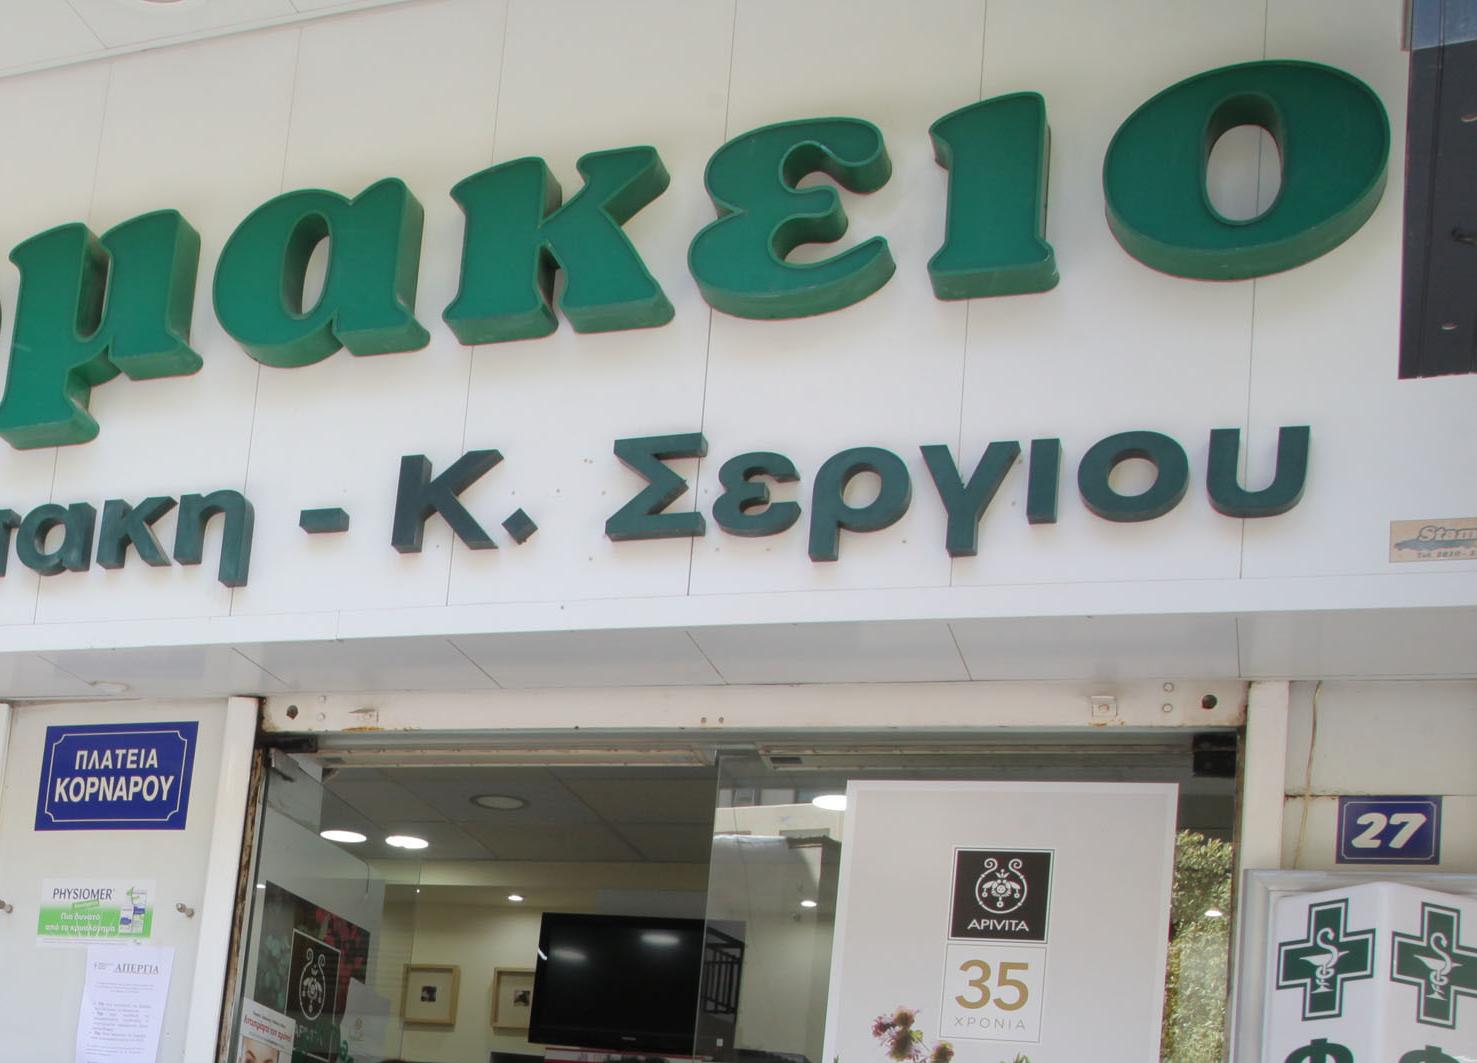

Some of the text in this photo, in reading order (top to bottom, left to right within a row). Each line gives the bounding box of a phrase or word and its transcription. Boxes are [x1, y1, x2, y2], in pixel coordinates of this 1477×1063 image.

[391, 448, 539, 554] Κ.
[605, 426, 1312, 563] Σεργιου
[74, 748, 160, 771] ΠΛΑΤΕΙΑ
[54, 774, 175, 803] ΚΟΡΝΑΡΟΥ
[1351, 812, 1427, 849] 27
[966, 918, 1030, 933] APIVITA
[954, 958, 1030, 1012] 35
[954, 1015, 1026, 1031] ΧΡΟΝΙΑ
